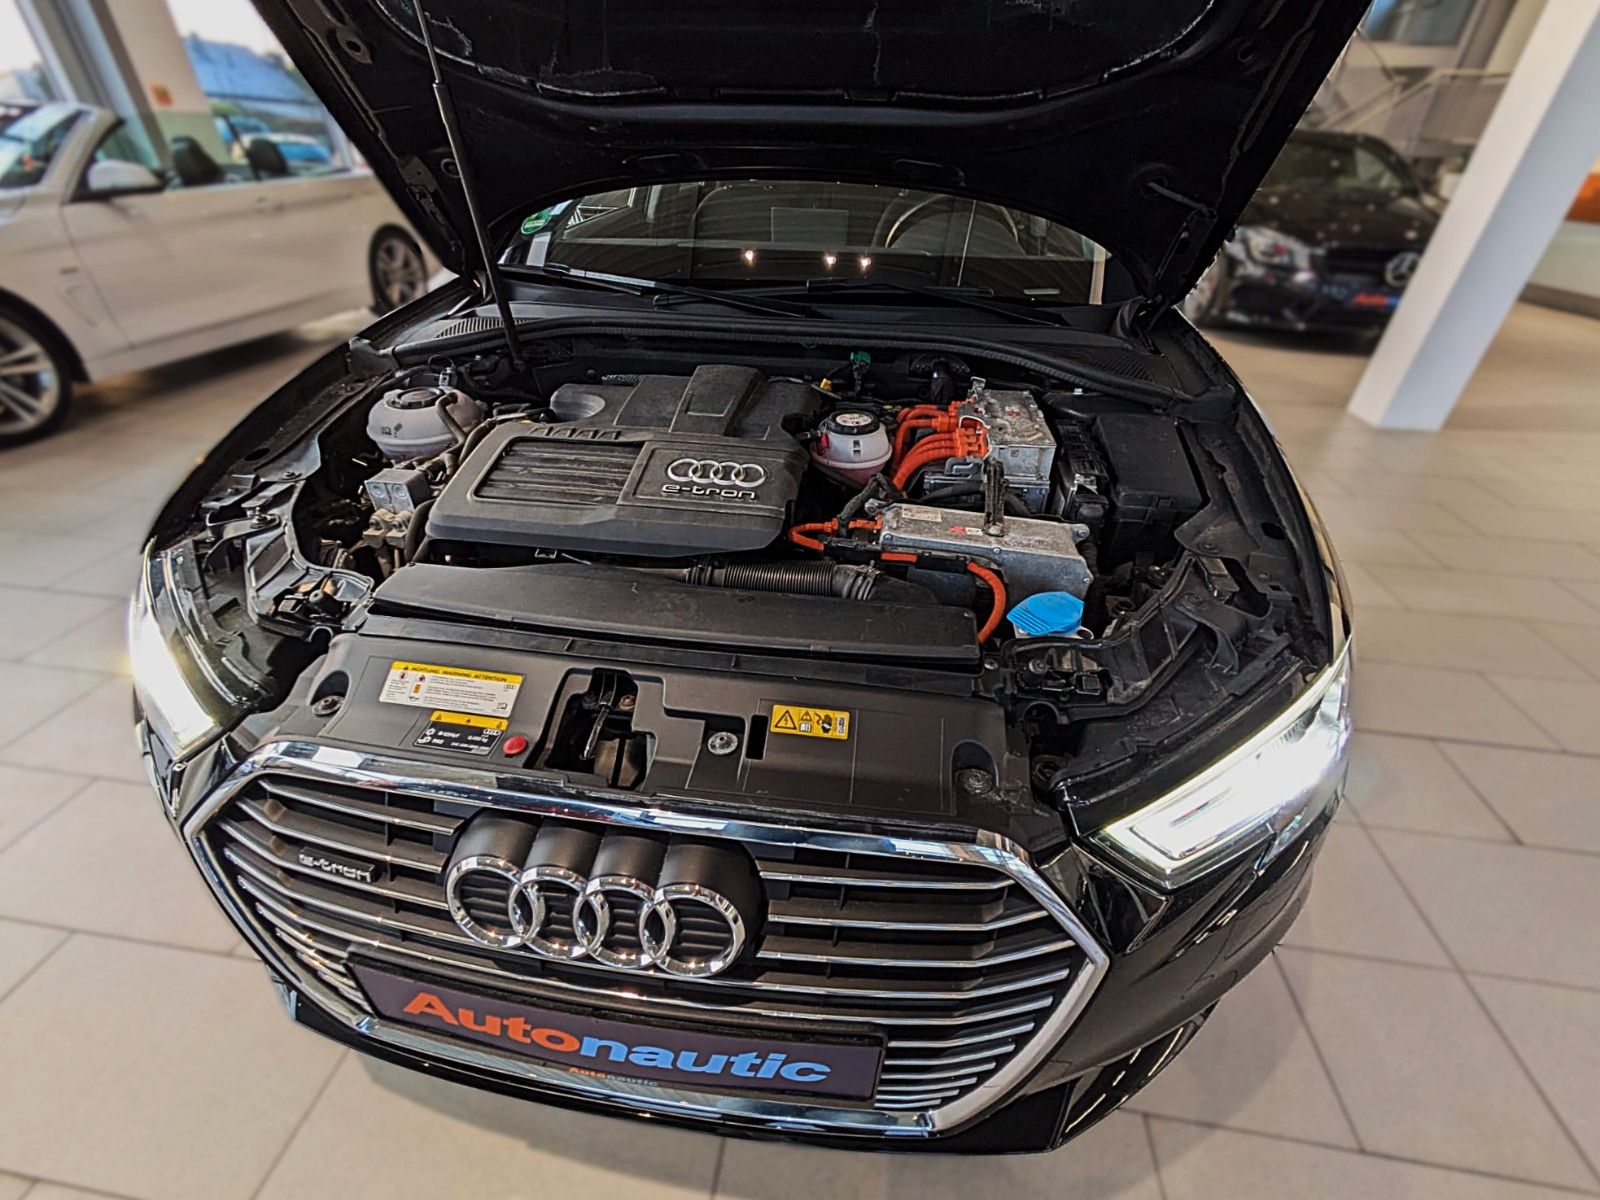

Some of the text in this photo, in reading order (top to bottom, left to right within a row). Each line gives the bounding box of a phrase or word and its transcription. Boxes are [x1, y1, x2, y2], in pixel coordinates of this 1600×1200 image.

[661, 484, 756, 500] e-tron
[298, 853, 372, 883] e-tron
[403, 991, 833, 1084] Autonautic
